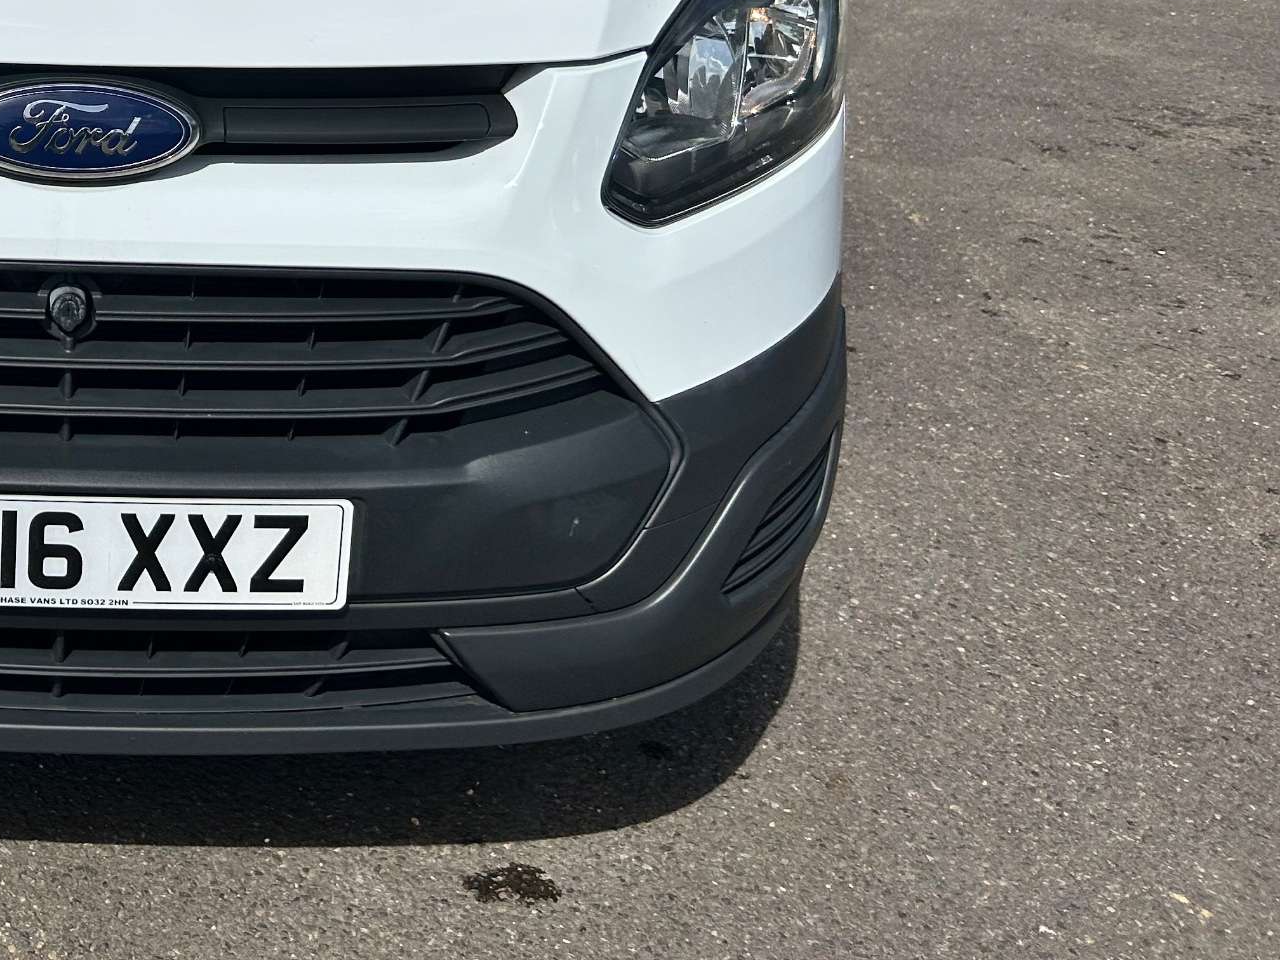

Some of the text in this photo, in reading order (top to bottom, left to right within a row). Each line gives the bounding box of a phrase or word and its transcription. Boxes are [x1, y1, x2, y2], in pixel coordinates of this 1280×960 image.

[8, 99, 142, 157] Ford
[117, 512, 310, 594] XXZ
[30, 597, 57, 605] VANS
[59, 598, 79, 606] LTD
[108, 599, 129, 607] 2HN
